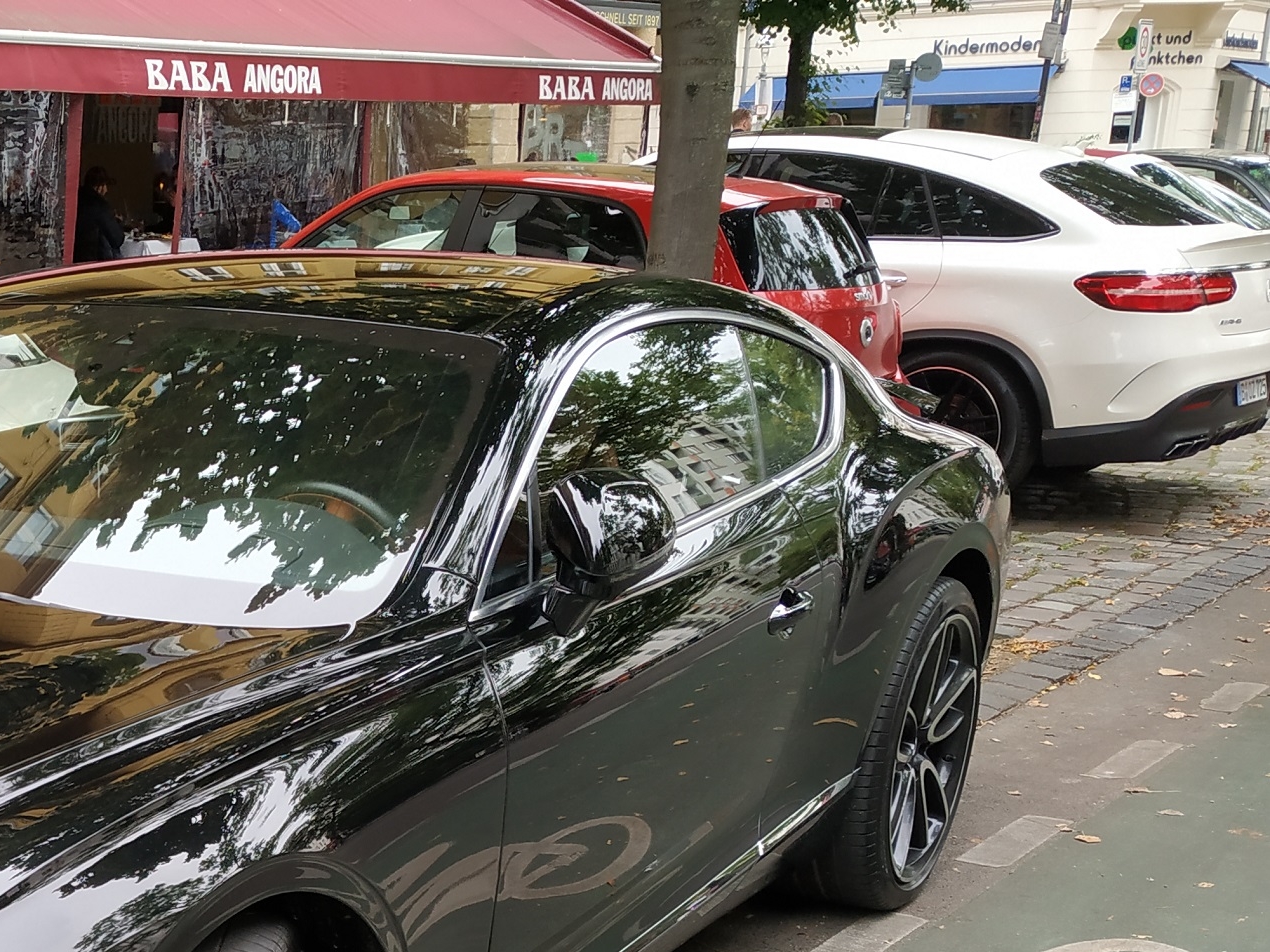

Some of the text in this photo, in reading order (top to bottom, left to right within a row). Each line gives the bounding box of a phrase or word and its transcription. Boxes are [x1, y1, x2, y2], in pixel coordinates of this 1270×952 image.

[628, 13, 643, 26] SEIT
[644, 15, 660, 27] 1897
[1165, 29, 1193, 45] und
[144, 58, 323, 95] BABA ANGORA
[538, 74, 654, 102] BABA ANGORA
